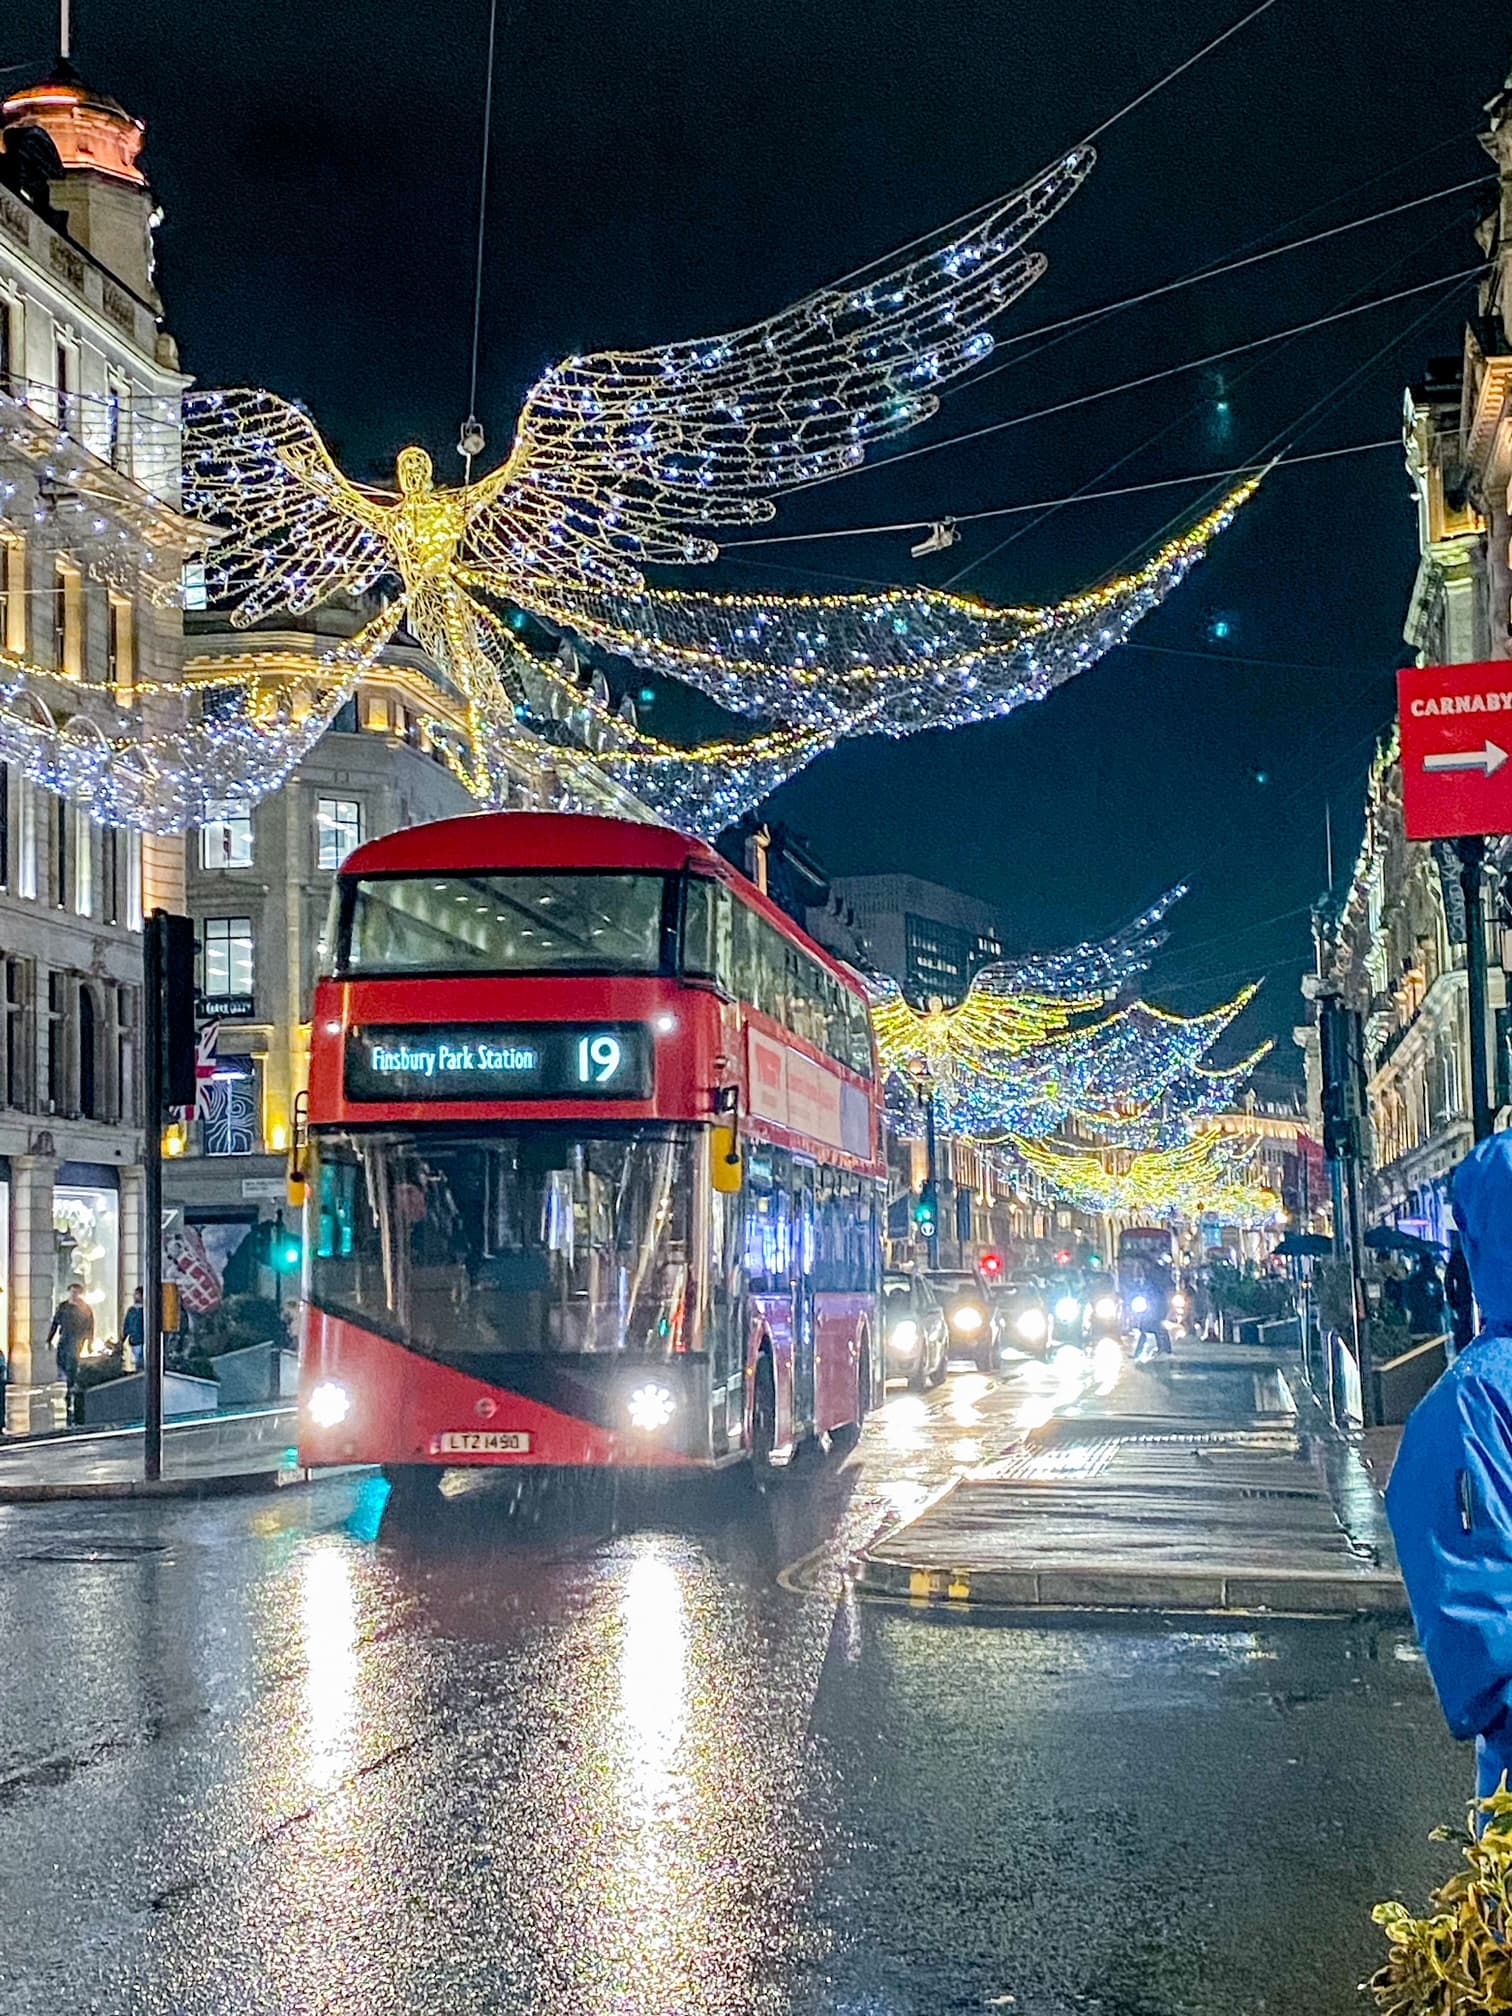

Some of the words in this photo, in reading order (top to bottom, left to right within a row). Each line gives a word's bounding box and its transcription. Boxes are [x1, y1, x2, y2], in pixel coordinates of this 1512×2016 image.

[1410, 692, 1512, 717] CARNABY
[1447, 884, 1467, 942] Calvin
[372, 1046, 436, 1076] Finsbury
[439, 1046, 475, 1070] Park
[477, 1045, 534, 1070] Station
[578, 1036, 621, 1082] 19
